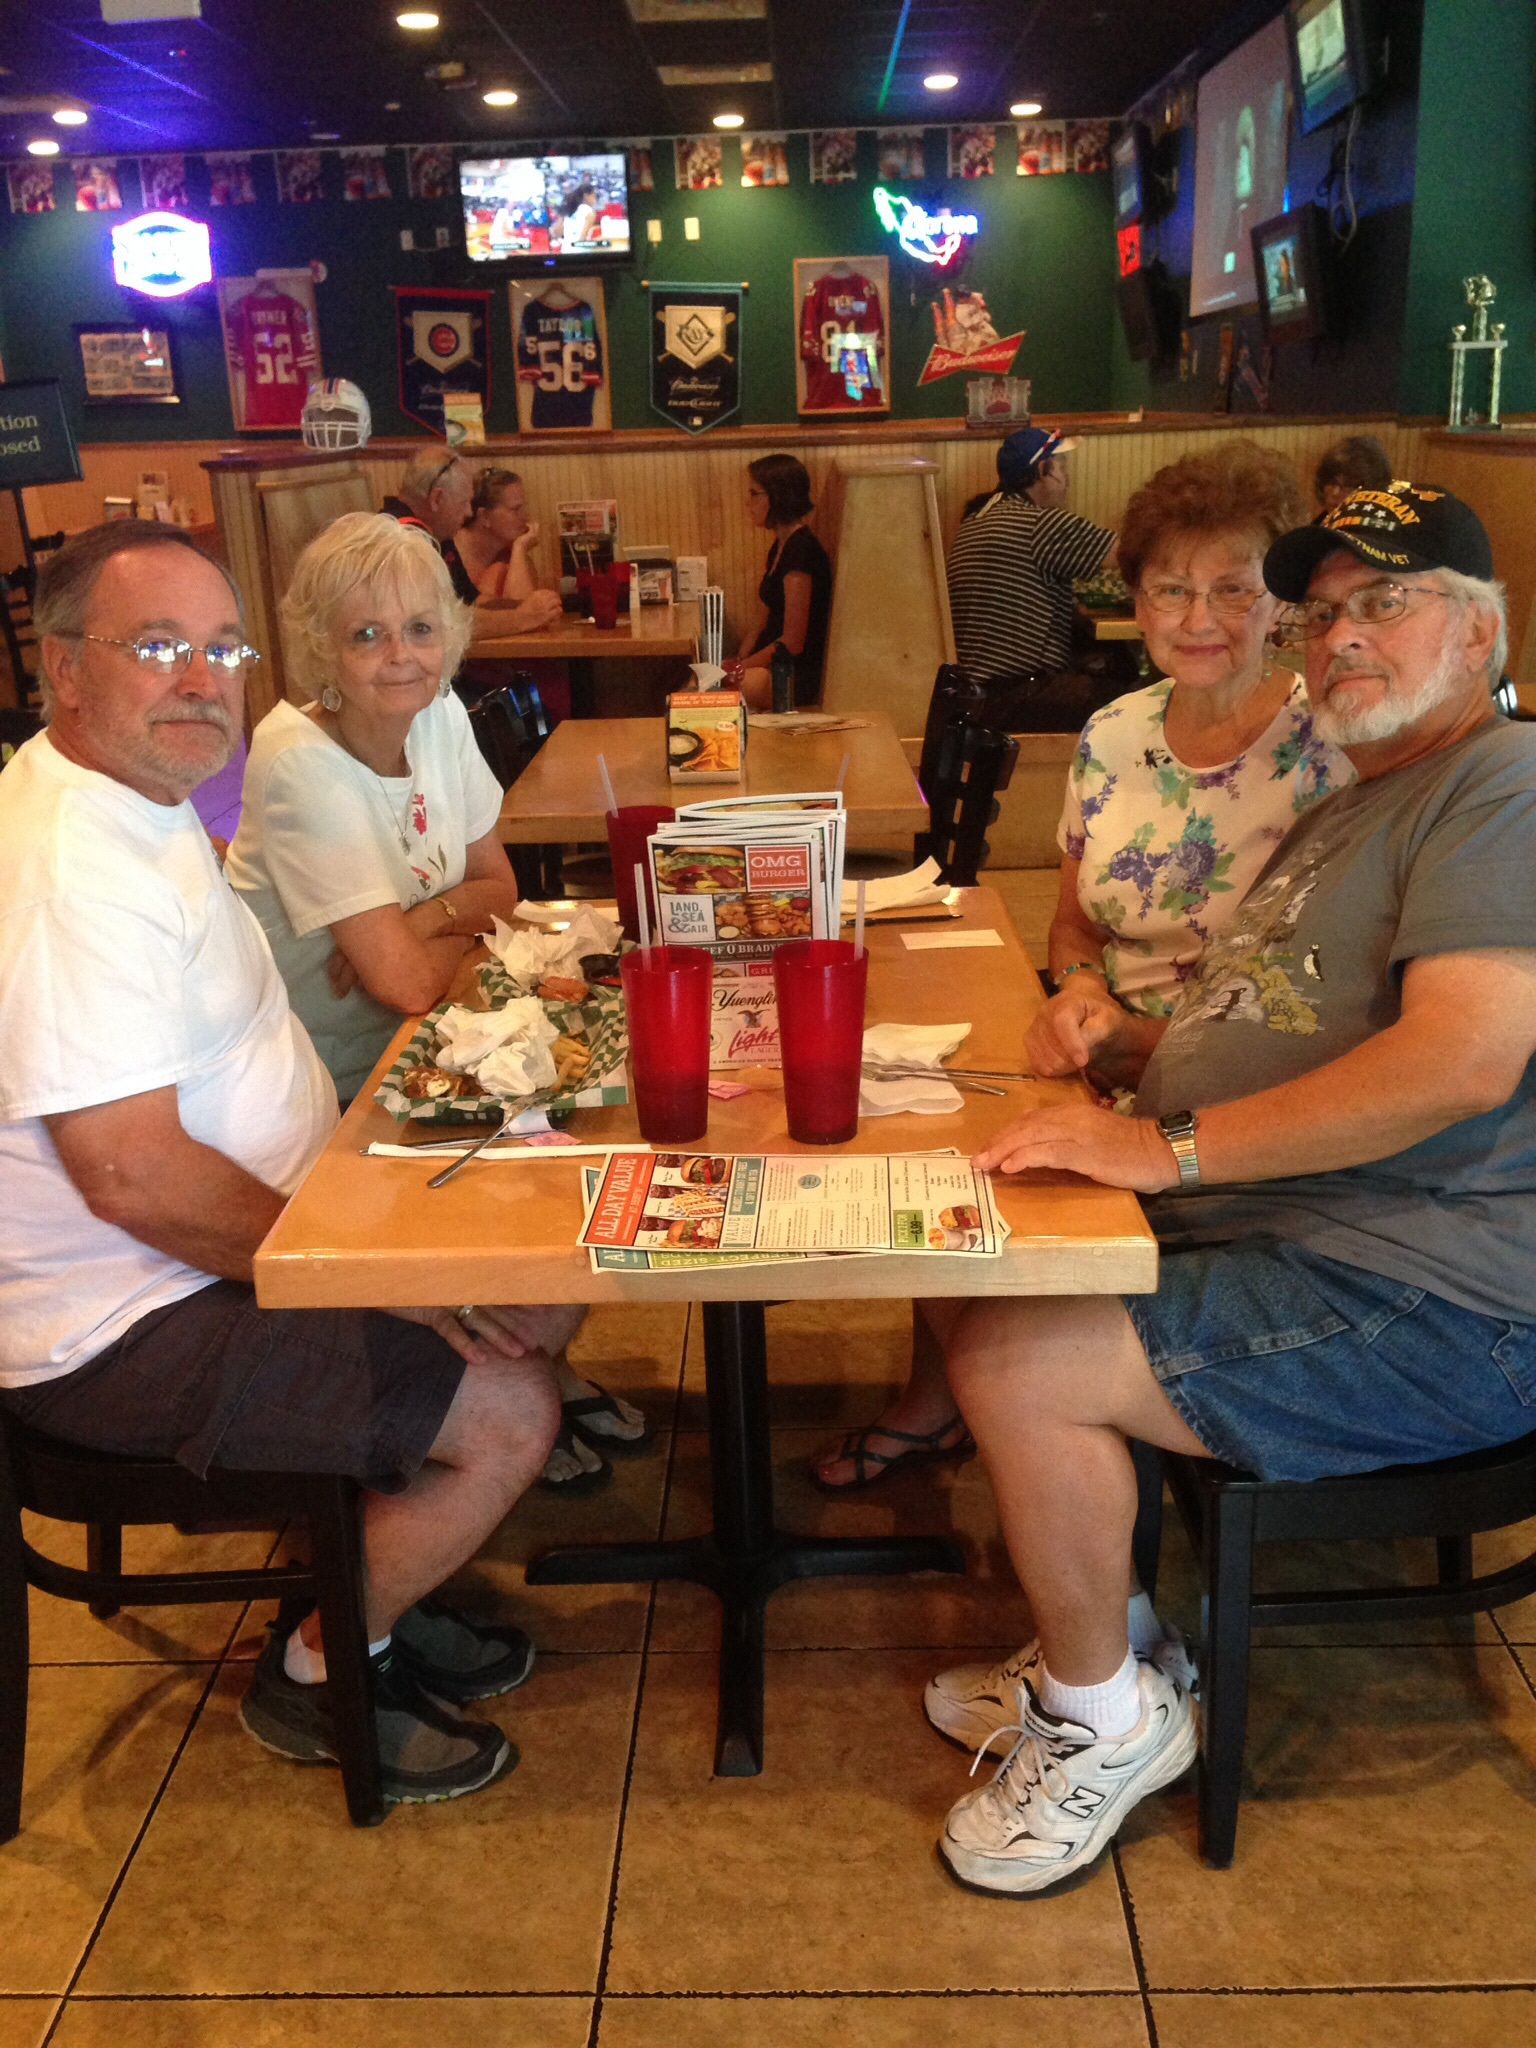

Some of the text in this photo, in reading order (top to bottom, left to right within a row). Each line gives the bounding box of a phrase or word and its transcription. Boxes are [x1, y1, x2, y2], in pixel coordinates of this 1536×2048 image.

[538, 341, 587, 392] 56
[1344, 490, 1421, 525] VETERAN
[1388, 552, 1411, 566] VET
[751, 855, 801, 868] OMG
[752, 868, 806, 879] BURGER
[681, 912, 705, 922] SEA
[690, 924, 709, 934] AIR
[727, 1026, 780, 1058] Light
[609, 1158, 638, 1194] VALUE
[601, 1194, 627, 1217] DAY
[594, 1219, 619, 1239] ALL
[725, 1217, 741, 1242] VALUE
[660, 1257, 709, 1267] SIZED
